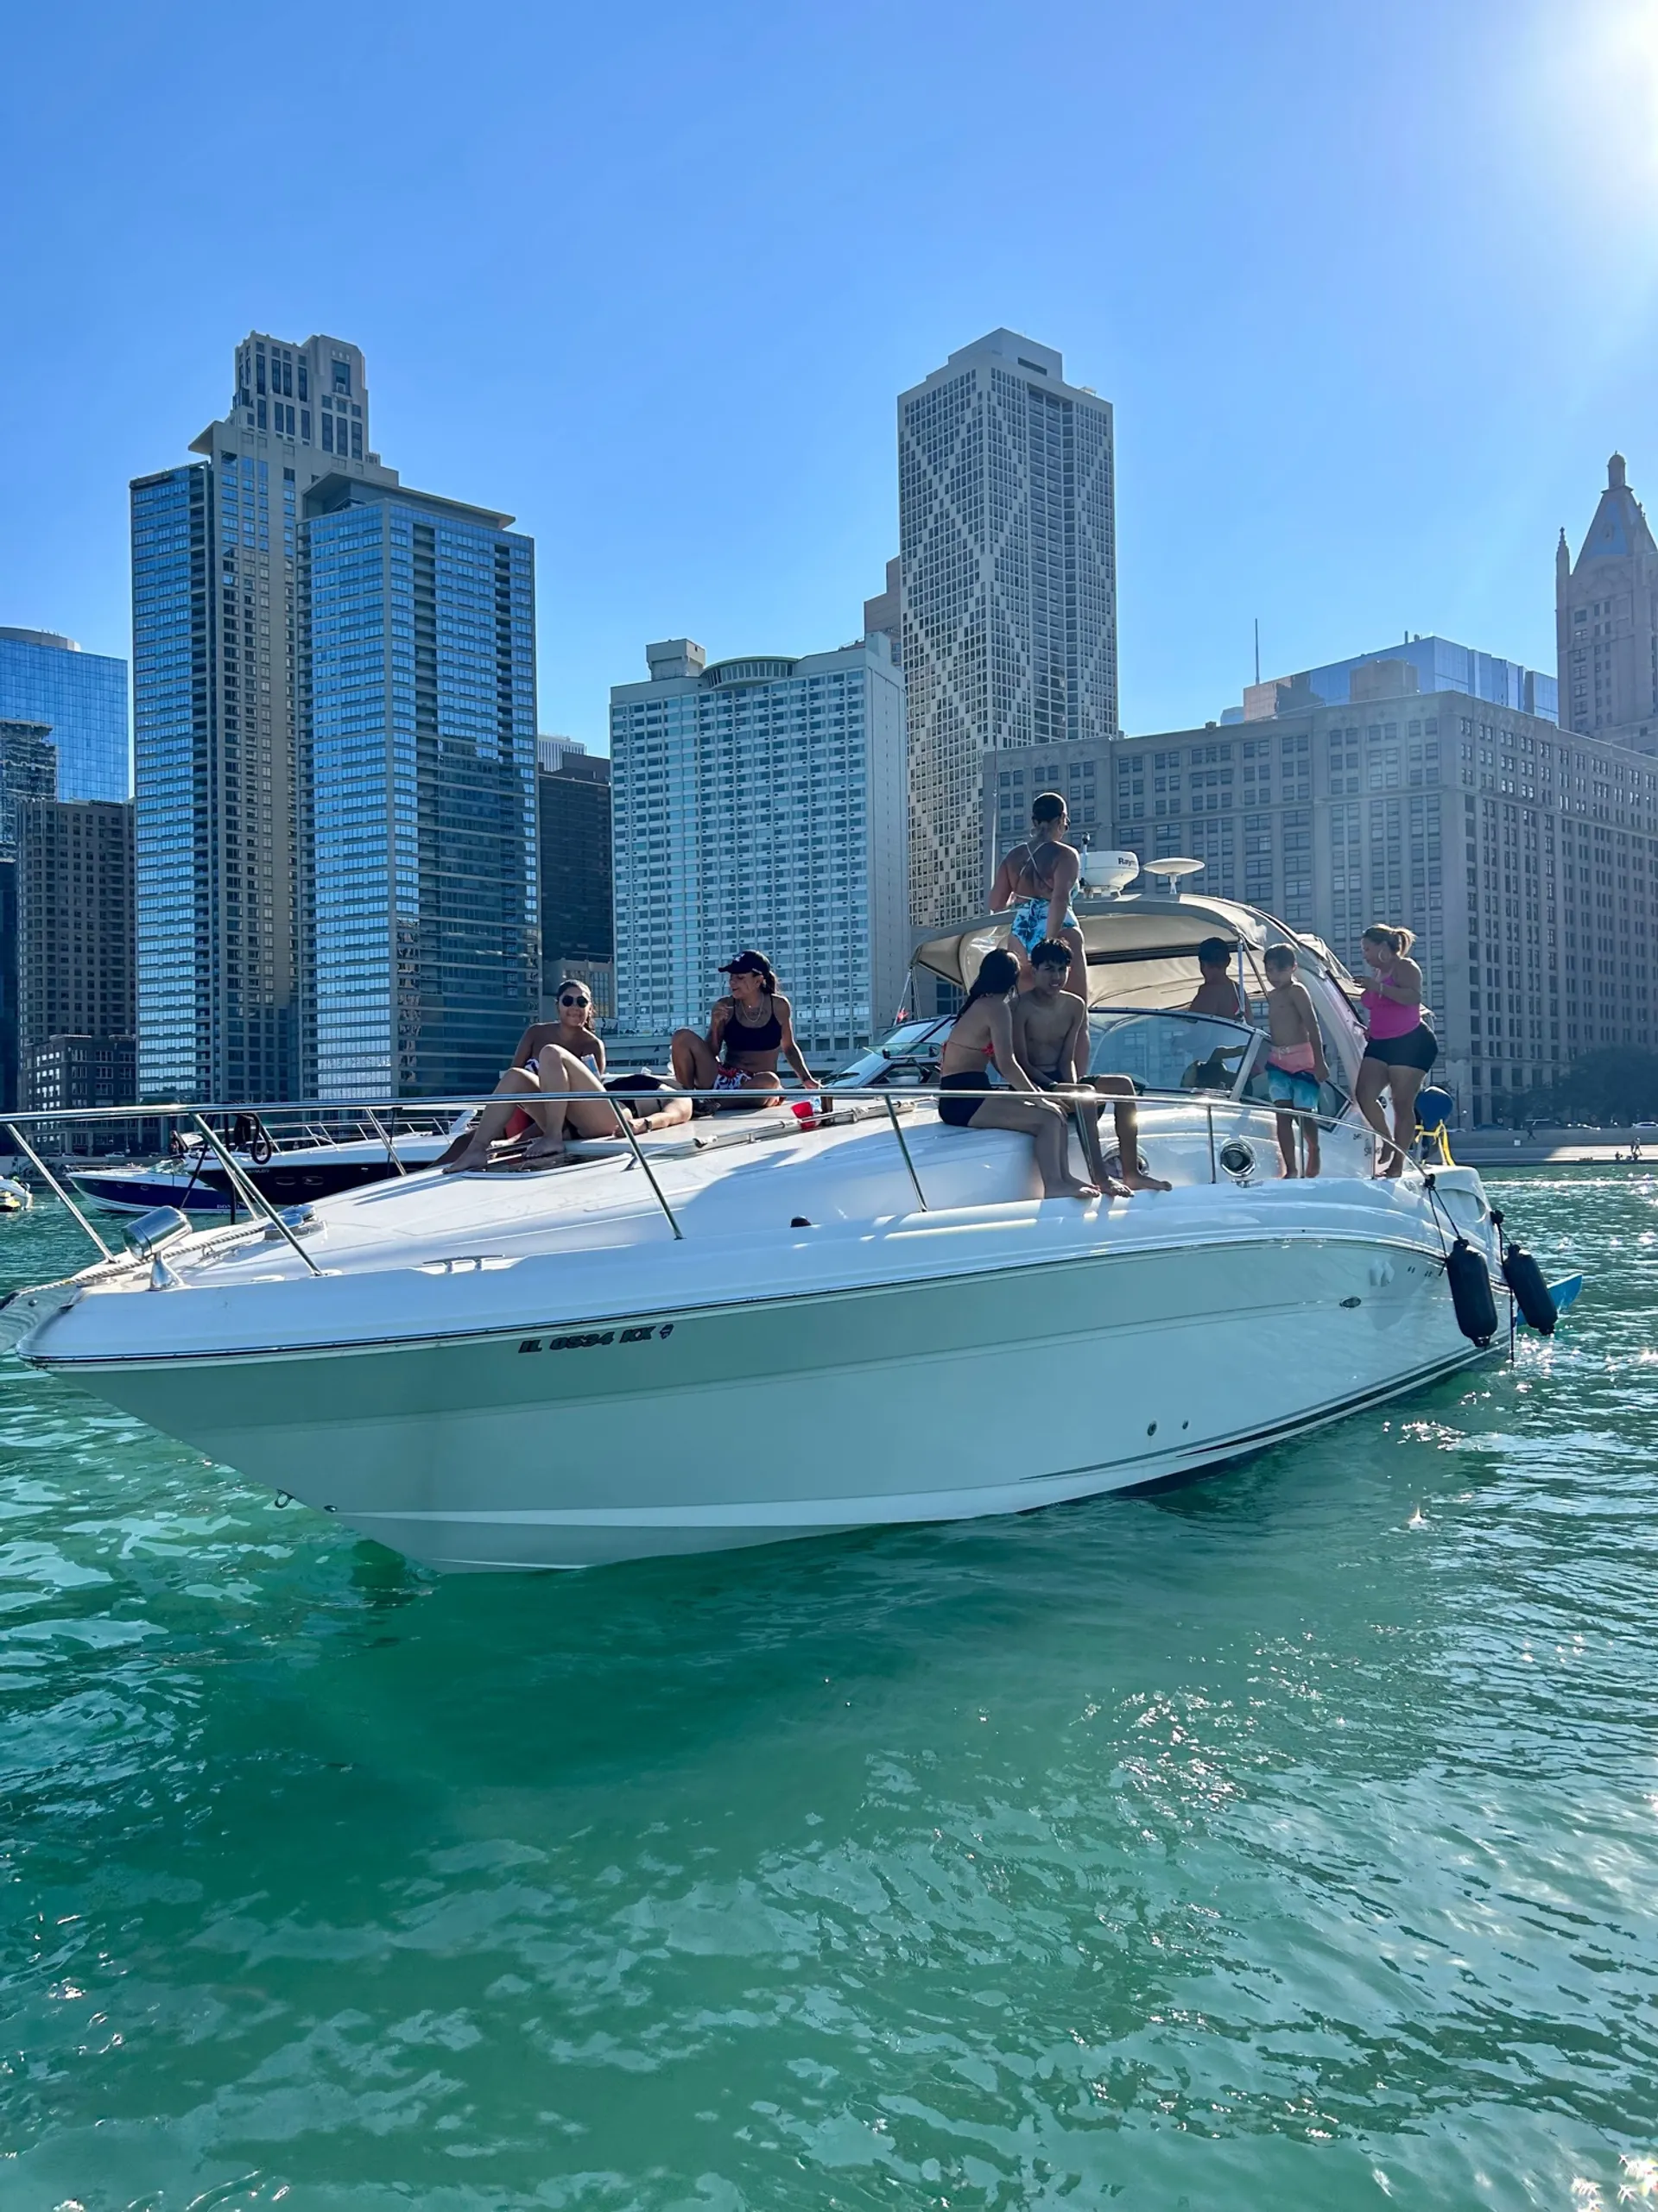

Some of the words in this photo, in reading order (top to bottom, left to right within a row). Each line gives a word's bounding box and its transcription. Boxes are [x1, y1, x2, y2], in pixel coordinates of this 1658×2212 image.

[518, 1339, 542, 1353] IL
[549, 1331, 615, 1350] 0534
[619, 1325, 656, 1343] KX
